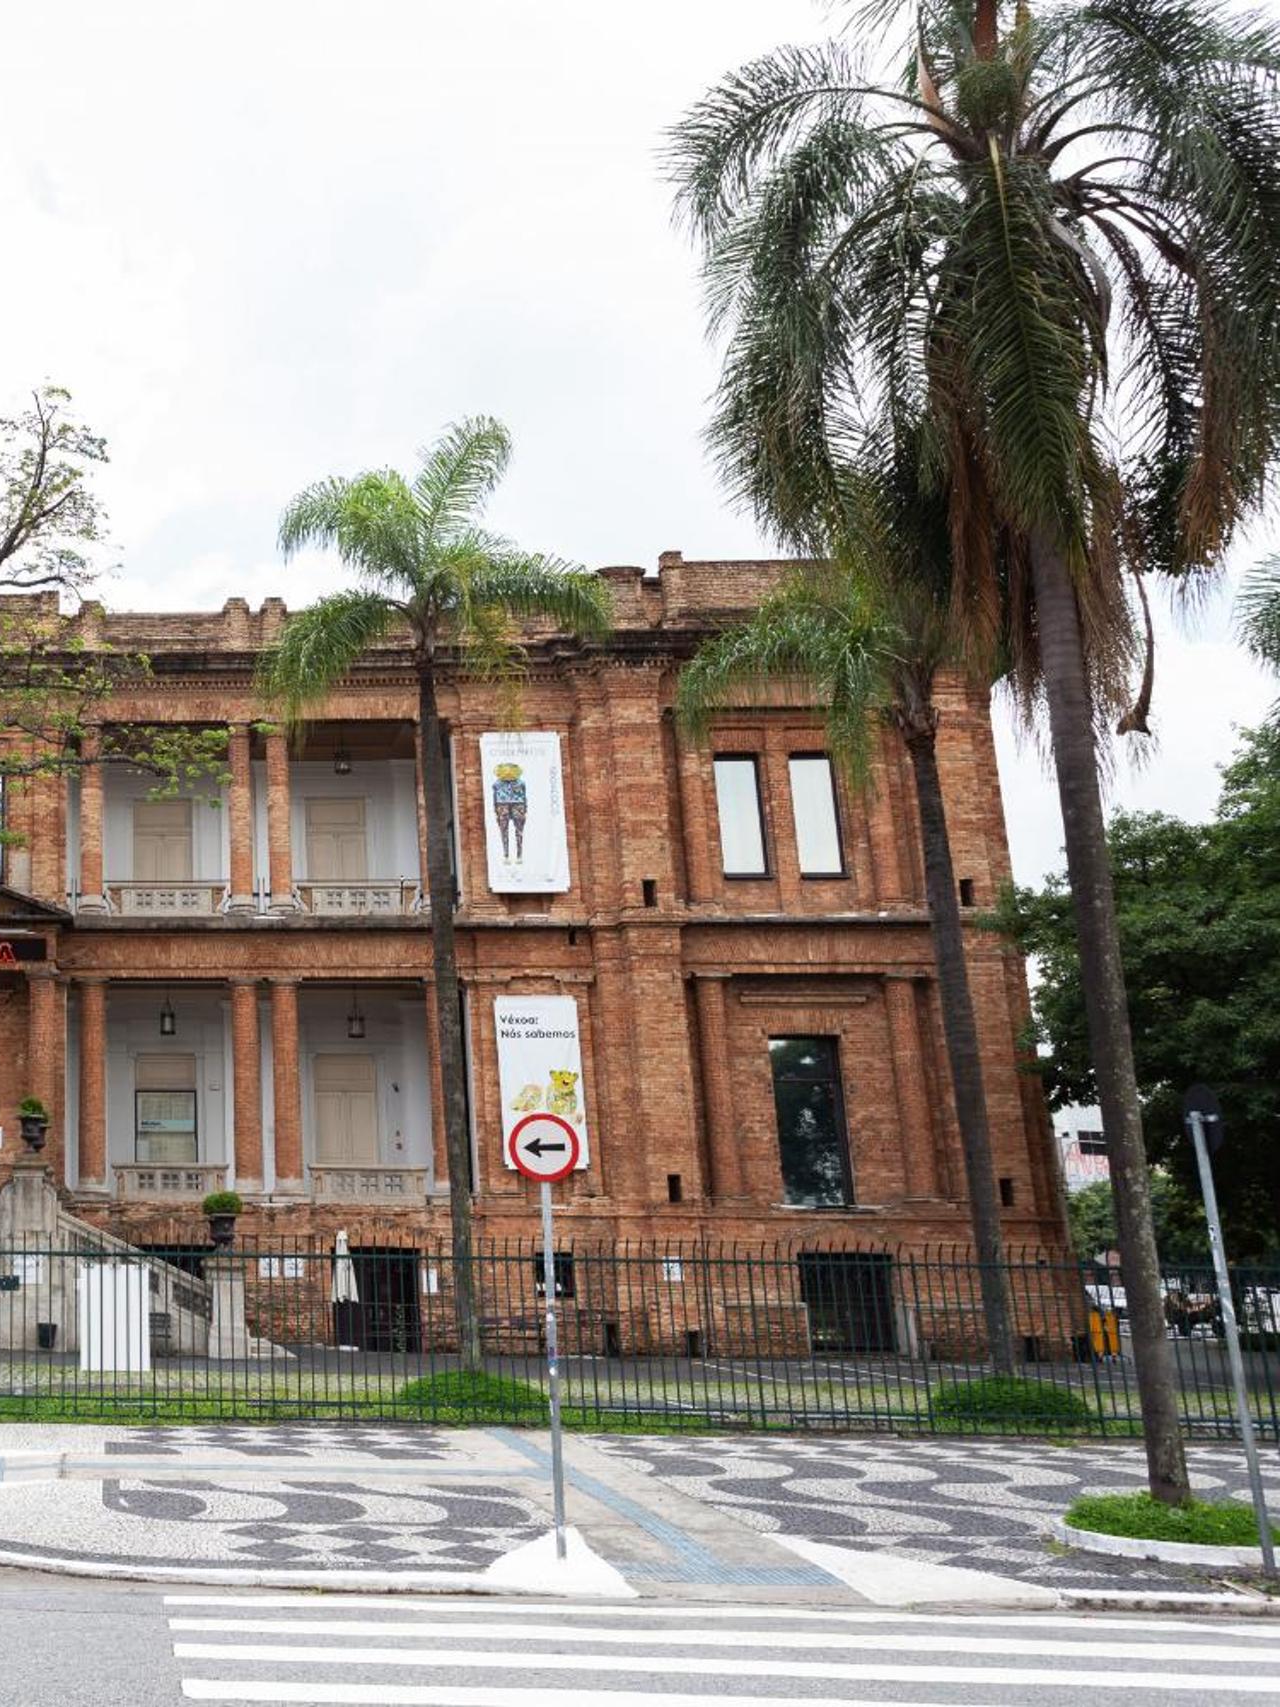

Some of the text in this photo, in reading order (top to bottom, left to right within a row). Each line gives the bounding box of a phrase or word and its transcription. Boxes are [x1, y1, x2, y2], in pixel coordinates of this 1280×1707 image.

[500, 1013, 539, 1025] Véxoa:
[501, 1027, 576, 1039] Nós sabemos
